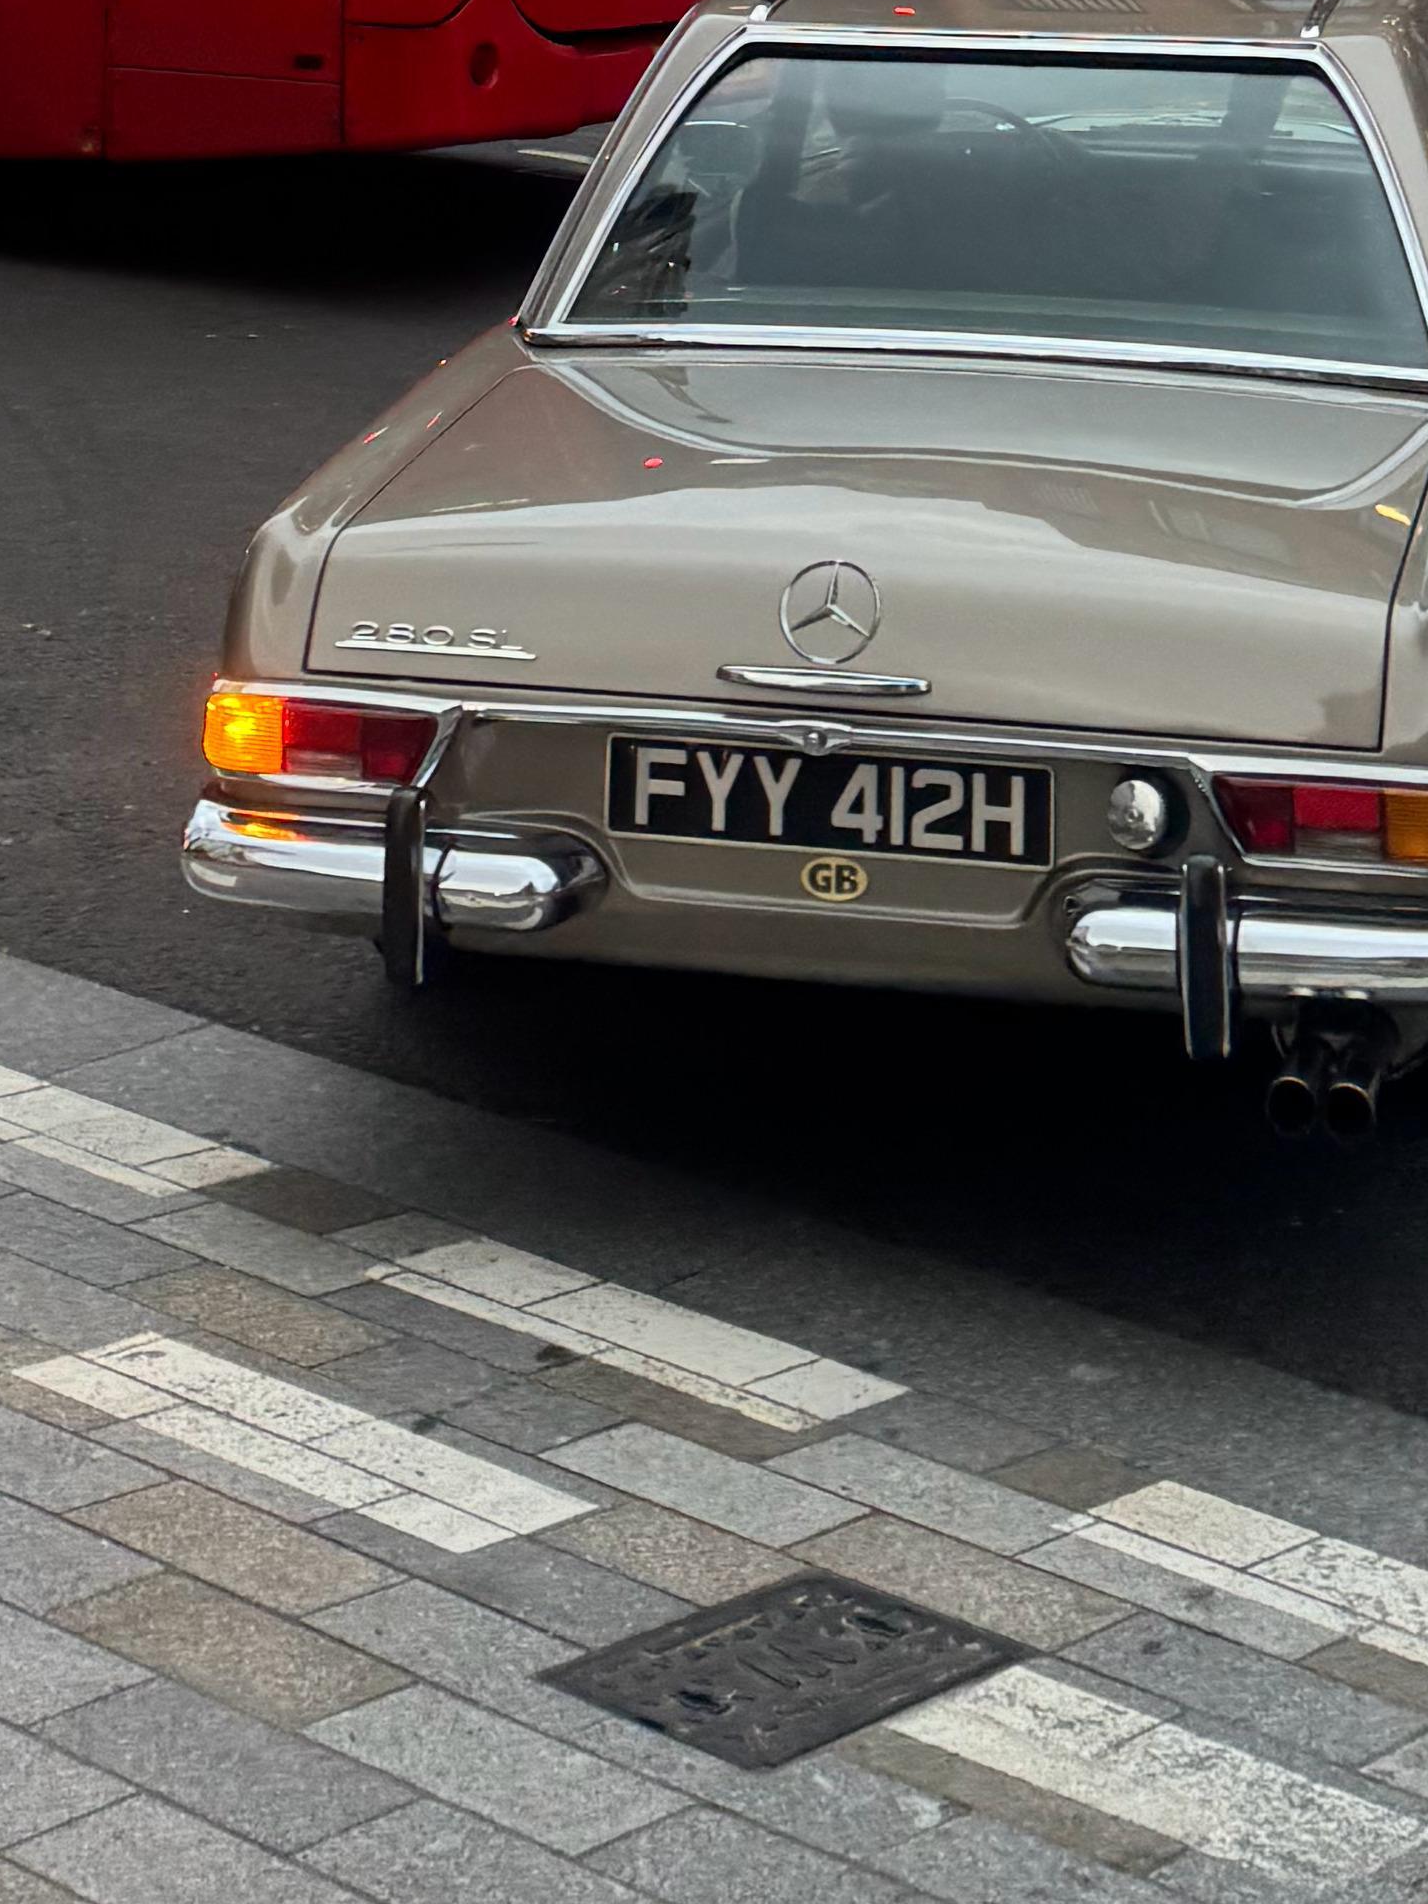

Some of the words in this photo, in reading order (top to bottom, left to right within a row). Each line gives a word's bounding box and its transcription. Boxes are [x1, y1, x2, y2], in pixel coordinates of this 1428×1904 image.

[351, 620, 454, 645] 280
[468, 628, 523, 651] SL
[635, 747, 801, 836] FYY
[831, 764, 1024, 856] 412H
[808, 863, 858, 895] GB
